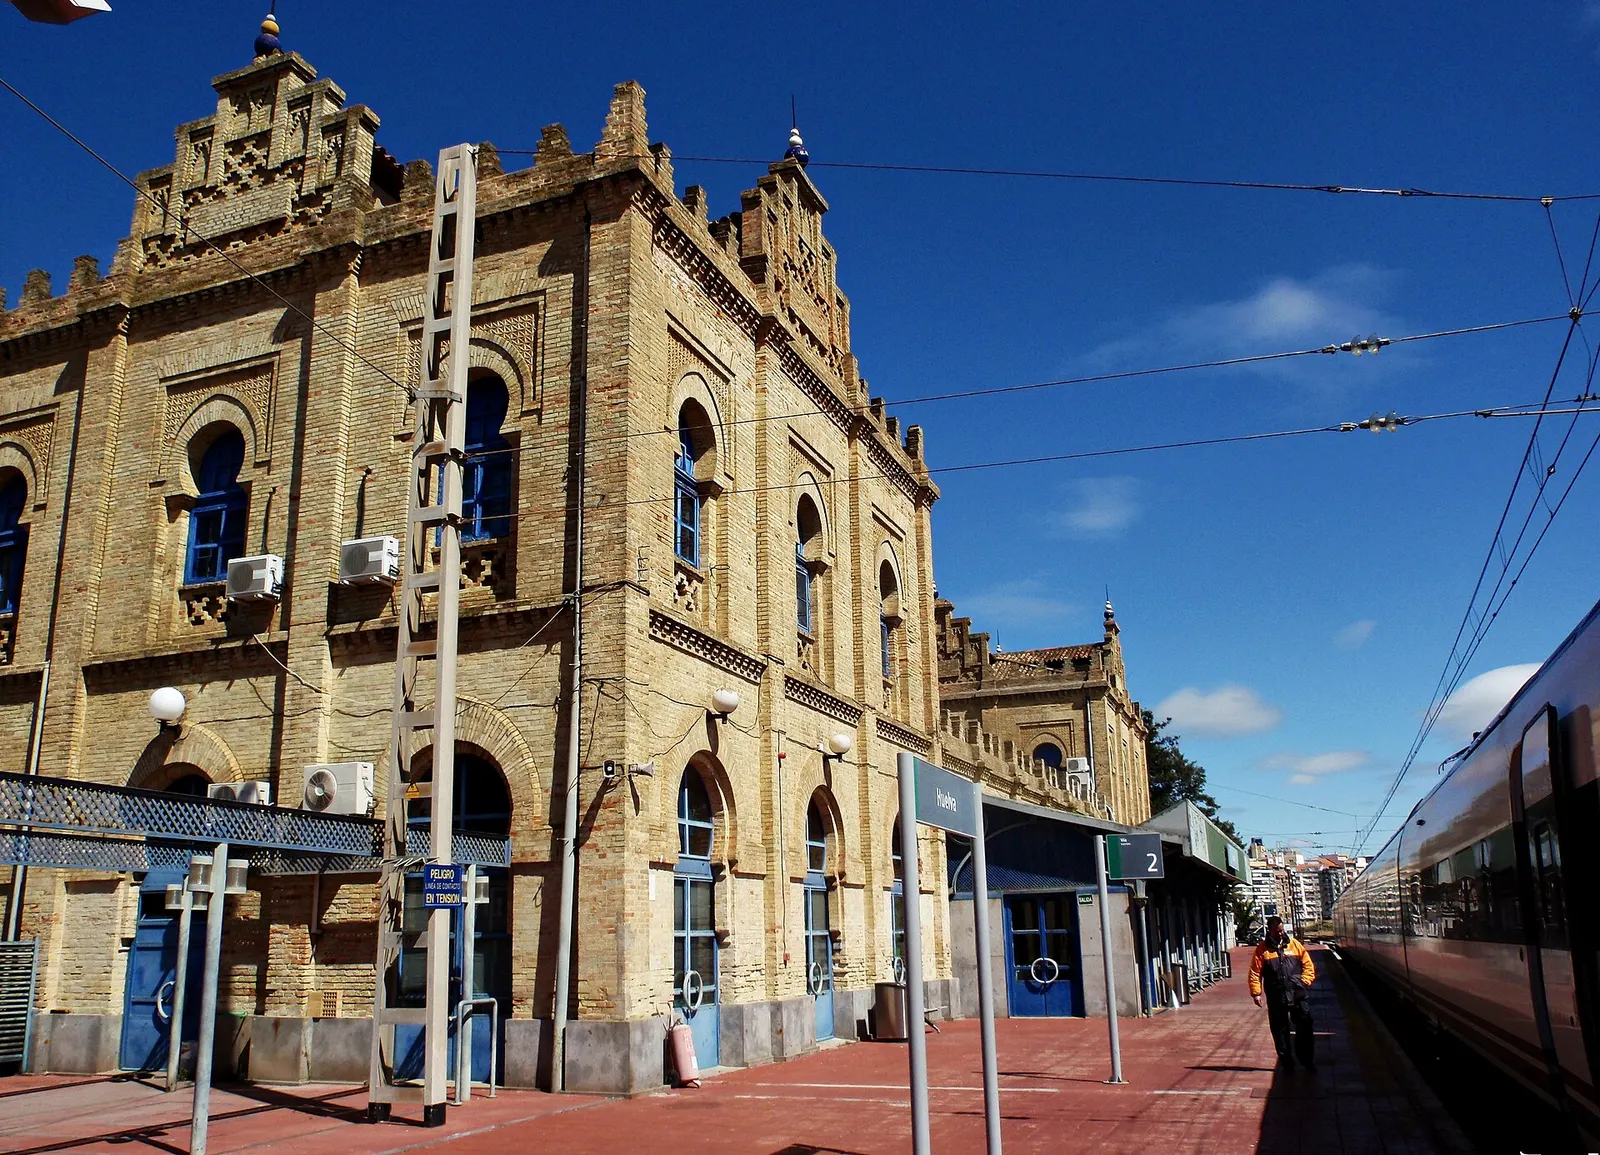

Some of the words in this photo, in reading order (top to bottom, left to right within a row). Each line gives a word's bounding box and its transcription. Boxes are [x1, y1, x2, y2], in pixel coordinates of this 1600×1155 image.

[936, 787, 957, 812] Huelva
[1146, 853, 1158, 872] 2
[430, 869, 455, 879] PELIGRO
[426, 893, 434, 903] EN
[435, 893, 460, 903] TENSION
